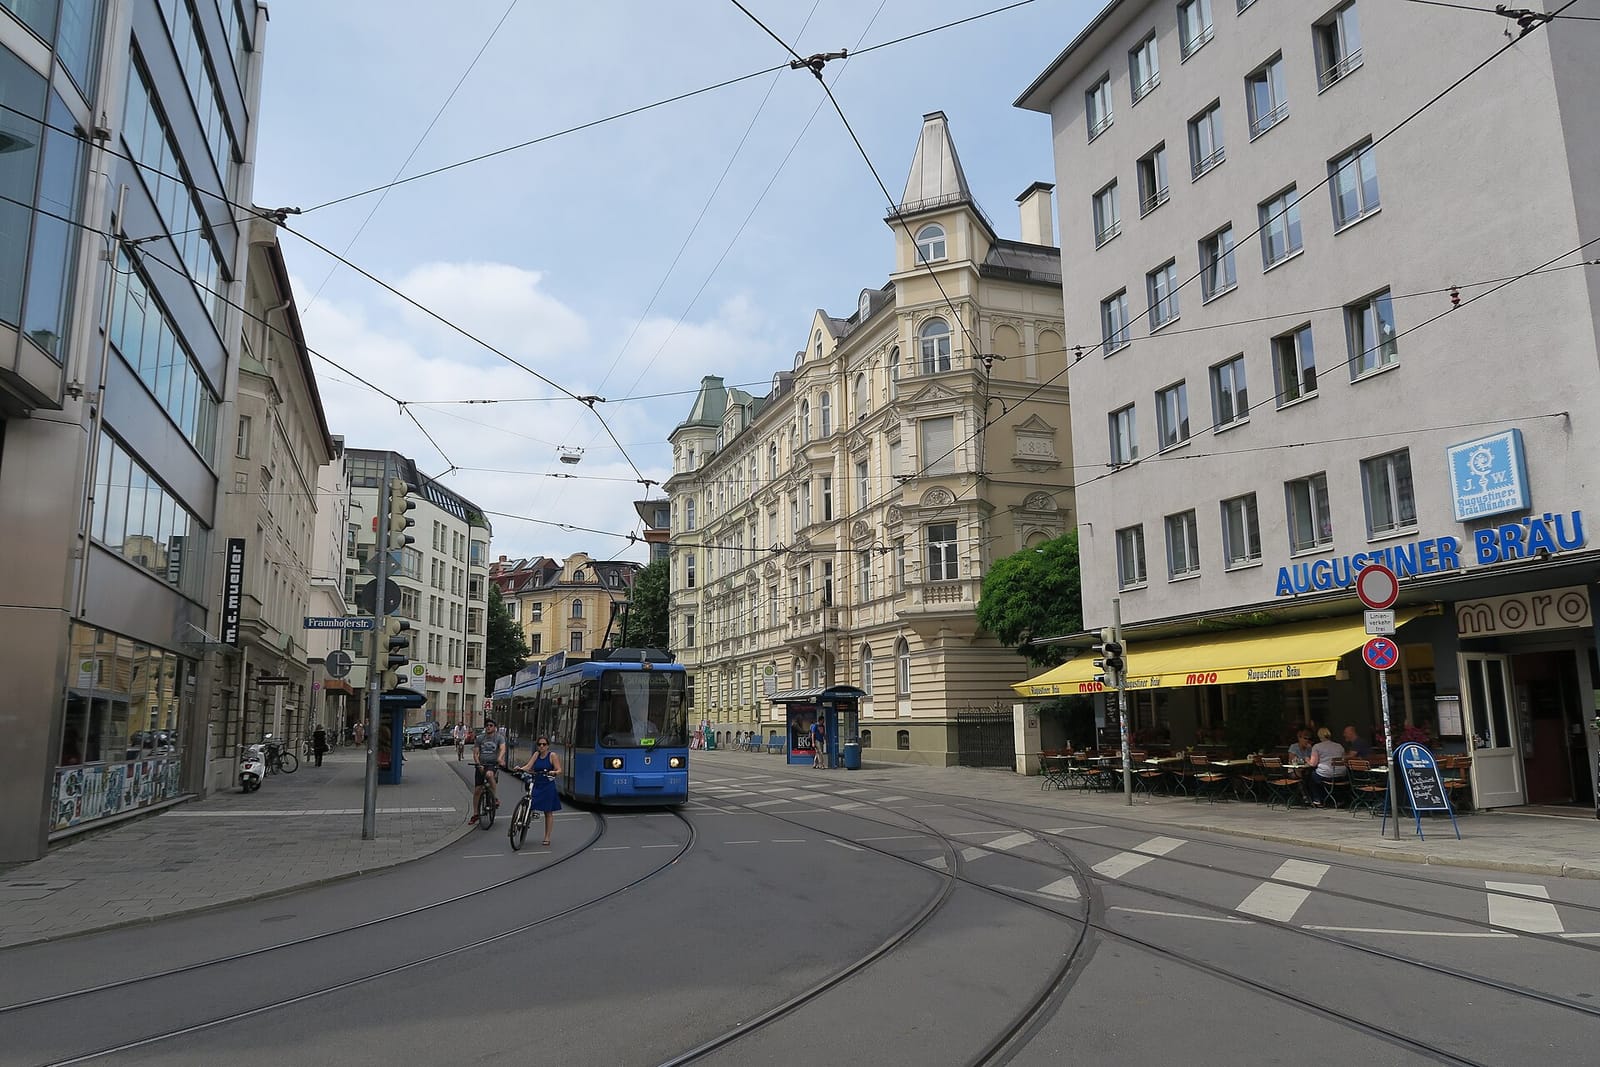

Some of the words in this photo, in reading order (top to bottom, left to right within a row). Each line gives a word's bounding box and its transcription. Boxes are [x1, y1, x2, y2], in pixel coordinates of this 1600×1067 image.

[1276, 536, 1461, 597] AUGUSTINER
[1474, 510, 1588, 565] BRÄU
[226, 545, 242, 643] m.c.mueller
[1457, 591, 1589, 635] moro
[308, 618, 369, 628] Fraunhoferstr.
[1078, 682, 1103, 693] moro
[1185, 672, 1218, 685] moro
[1247, 667, 1283, 681] Augustiner
[1286, 665, 1301, 678] Bräu
